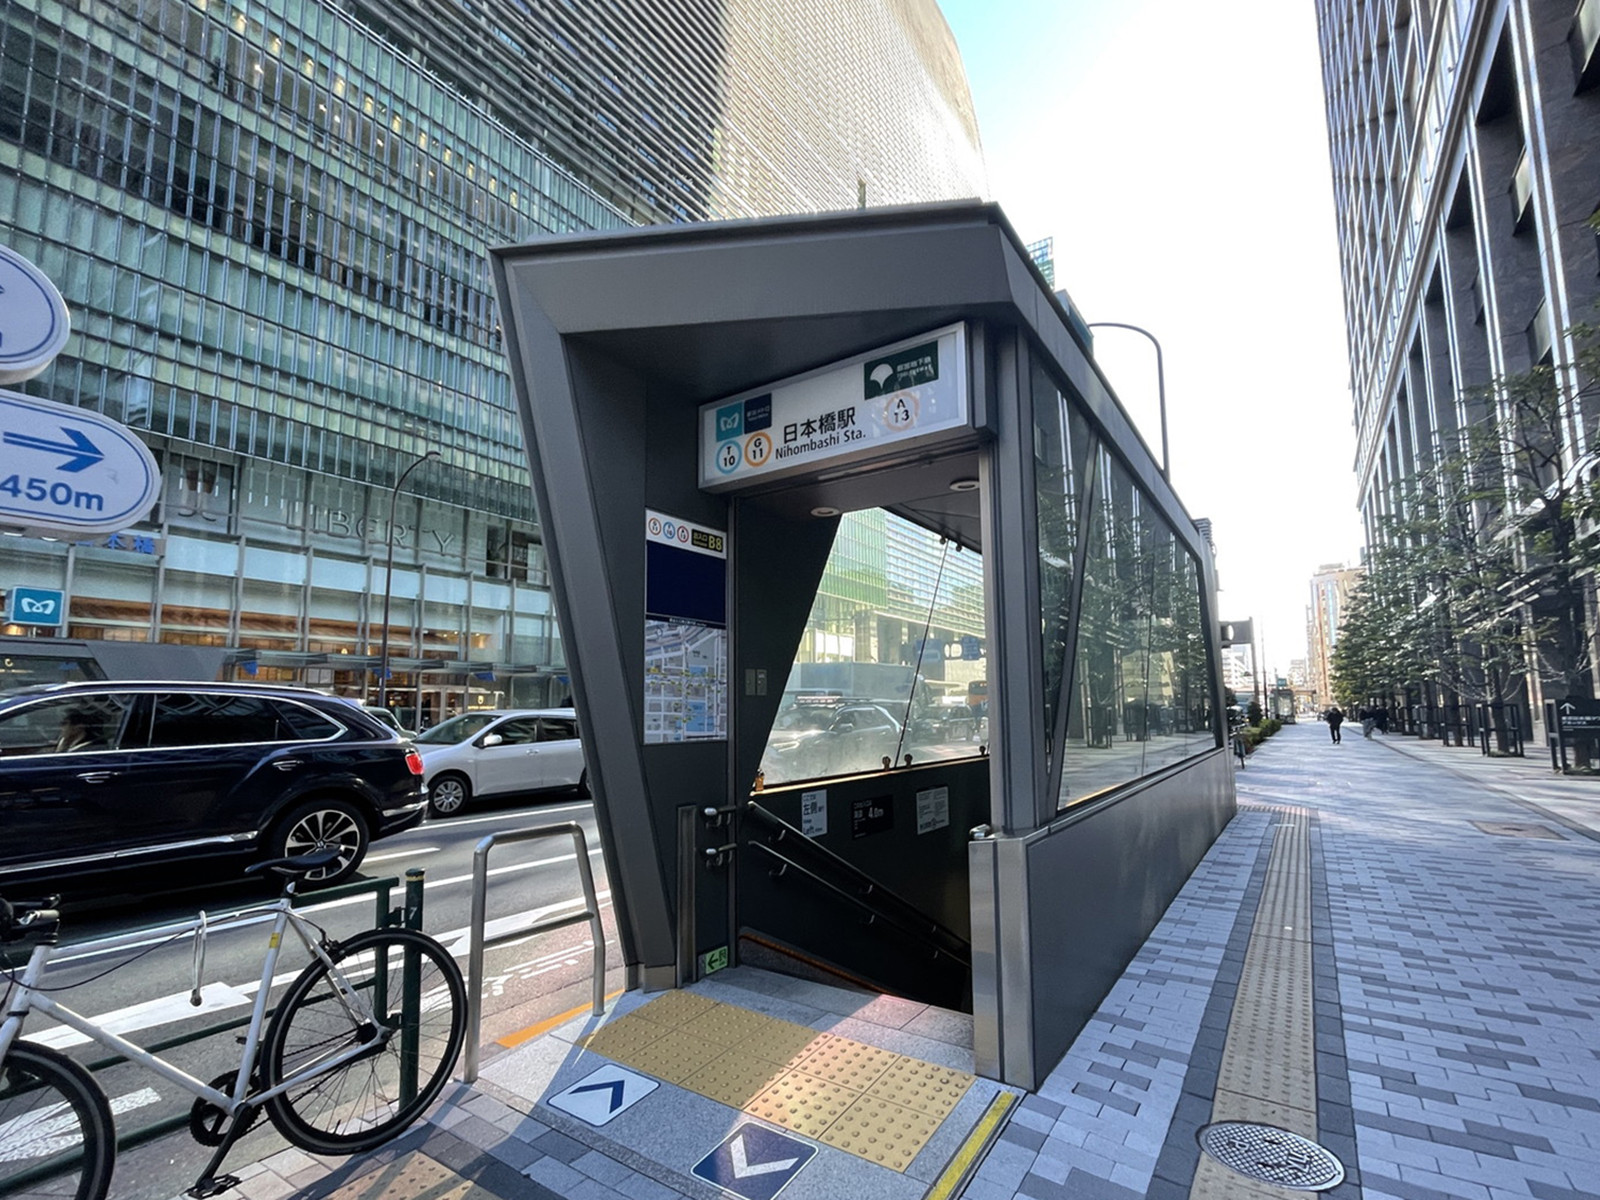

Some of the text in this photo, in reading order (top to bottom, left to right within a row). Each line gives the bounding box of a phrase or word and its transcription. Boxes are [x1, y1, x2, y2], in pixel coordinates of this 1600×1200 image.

[896, 398, 906, 409] A
[783, 406, 856, 445] 日本橋駅
[753, 437, 762, 448] G
[775, 429, 867, 460] Nihombashi Sta.
[726, 446, 732, 456] T
[752, 448, 764, 460] 11
[723, 455, 736, 467] 10
[0, 474, 104, 512] 450m
[75, 532, 156, 555] 本橋
[708, 535, 723, 551] B8
